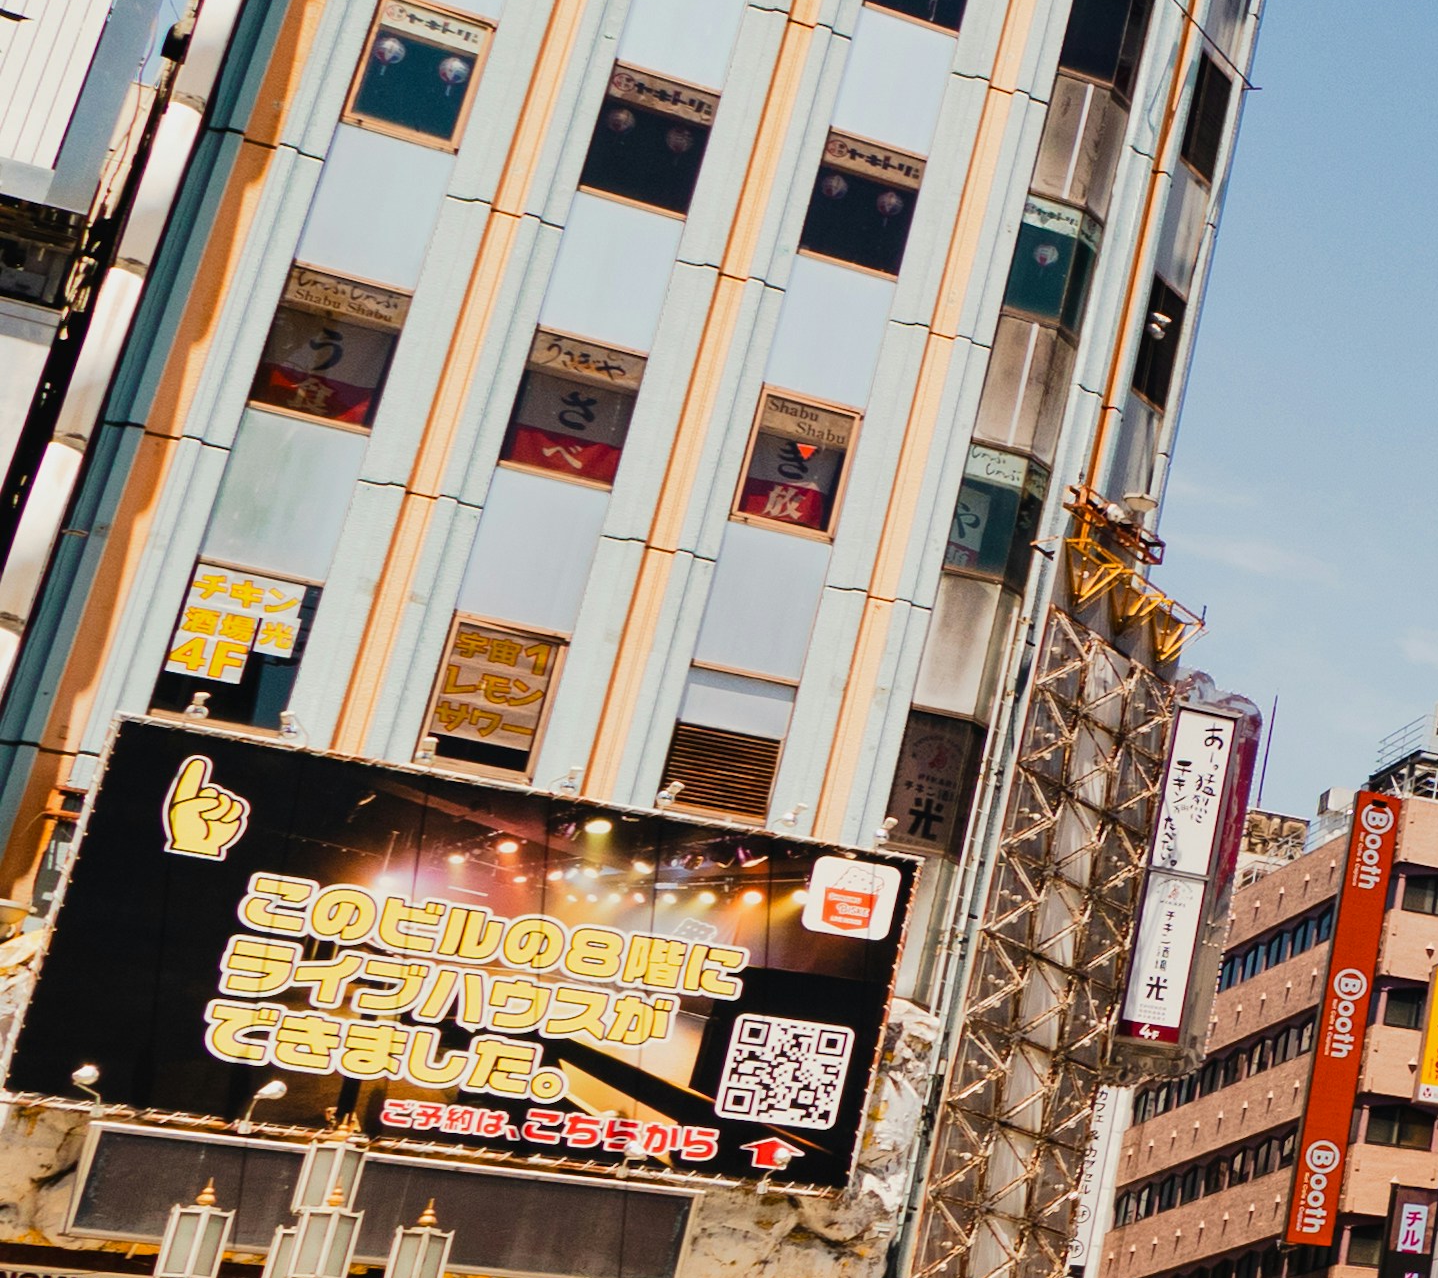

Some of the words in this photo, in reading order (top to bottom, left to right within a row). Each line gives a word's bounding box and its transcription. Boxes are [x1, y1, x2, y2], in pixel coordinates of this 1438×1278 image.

[293, 288, 343, 312] Shabu
[345, 299, 394, 324] Shabu
[767, 397, 821, 423] Shabu
[793, 420, 848, 446] Shabu
[190, 566, 305, 618] チキン
[178, 604, 299, 657] 酒場光
[166, 636, 247, 683] 4F
[446, 660, 546, 712] レモン
[433, 697, 537, 744] サワー
[1357, 804, 1396, 892] Booth
[236, 870, 751, 1003] このビルの8階に
[219, 934, 679, 1048] ライブハウスが
[1146, 976, 1169, 1002] 光
[1330, 965, 1369, 1060] Booth
[204, 999, 568, 1104] できました。
[1138, 1022, 1161, 1040] 4F
[381, 1100, 720, 1162] ご予約は、こちらから
[1301, 1137, 1341, 1237] Booth
